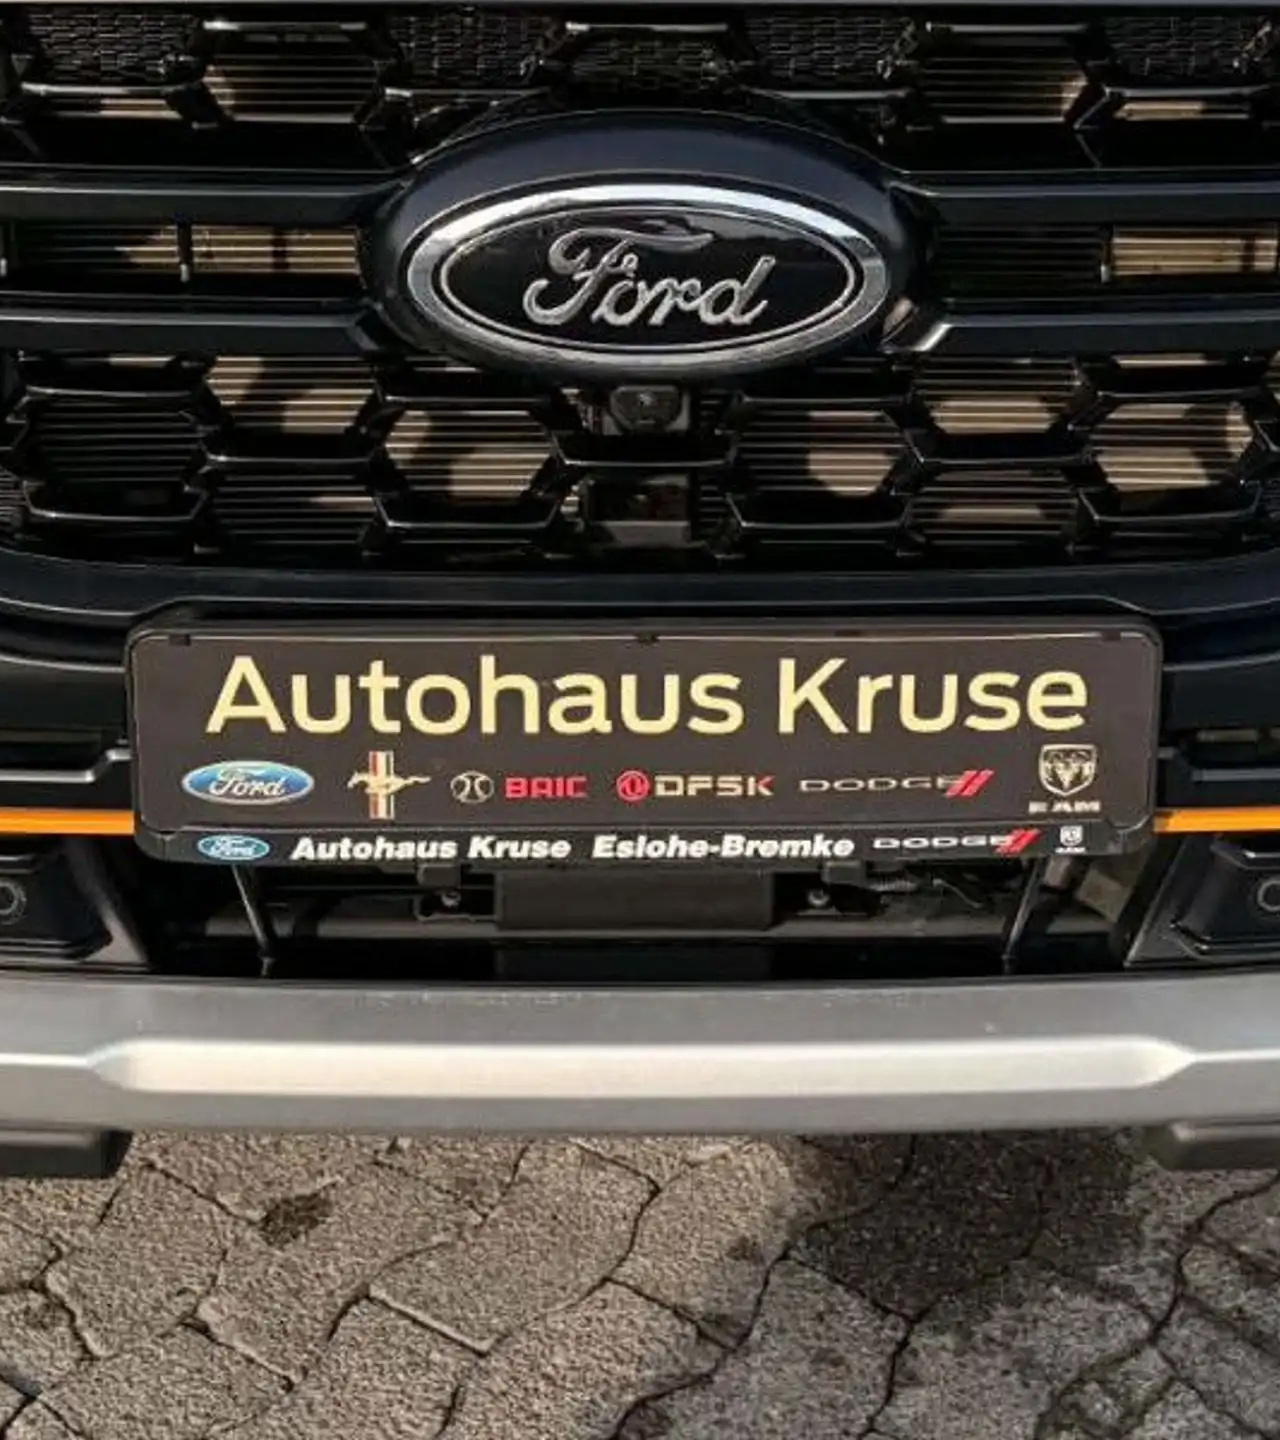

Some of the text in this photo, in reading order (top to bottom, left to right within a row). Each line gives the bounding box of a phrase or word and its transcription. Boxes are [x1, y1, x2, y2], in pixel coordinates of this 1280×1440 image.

[522, 225, 776, 327] Ford
[205, 654, 1089, 736] Autohaus Kruse
[208, 766, 287, 797] Ford
[505, 775, 589, 799] BAIC
[653, 774, 776, 797] DFSK
[799, 772, 966, 792] DODGE
[289, 833, 856, 860] Autohaus Kruse Eslohe-Bremke
